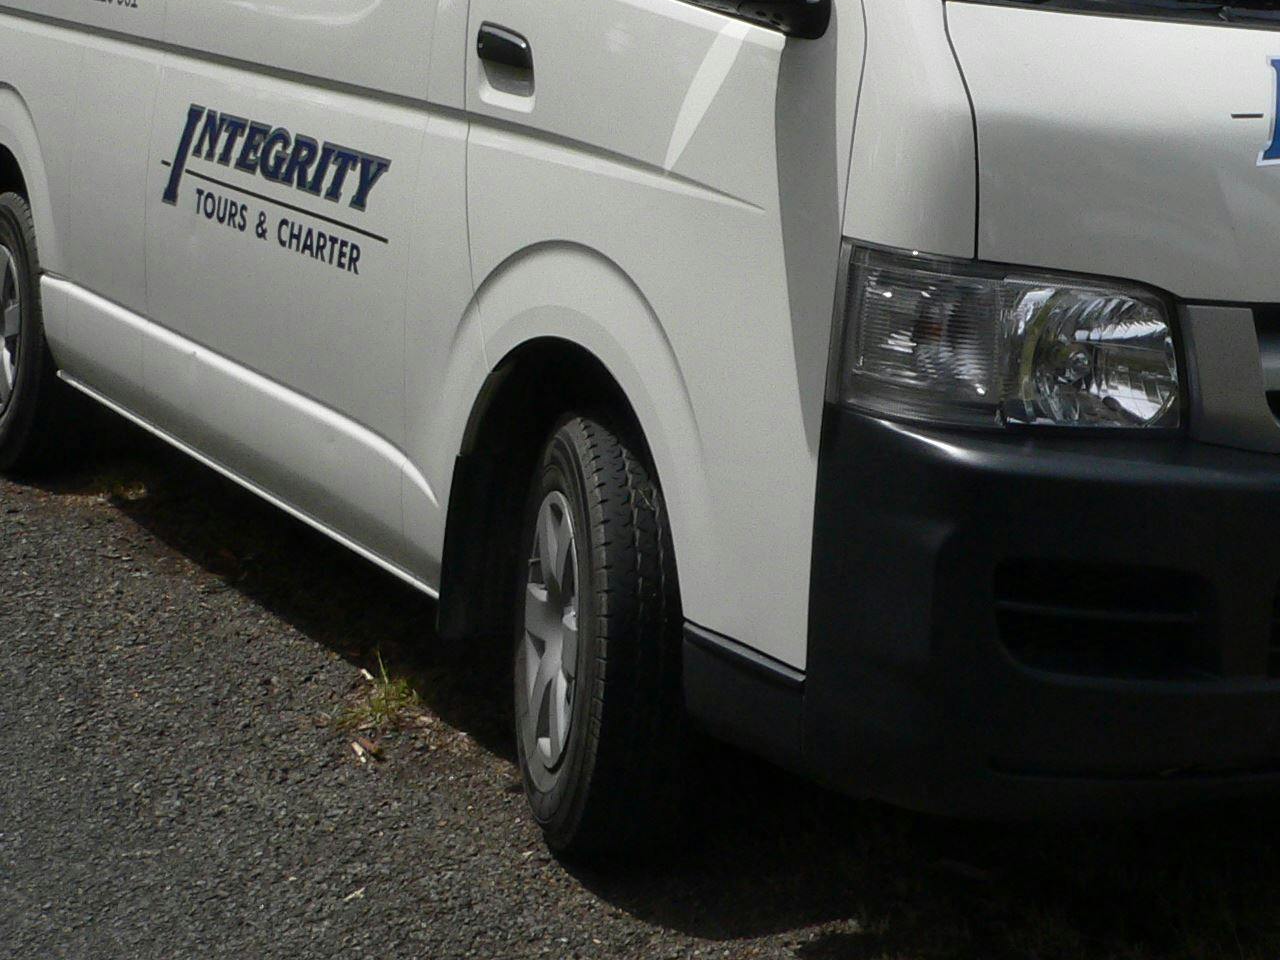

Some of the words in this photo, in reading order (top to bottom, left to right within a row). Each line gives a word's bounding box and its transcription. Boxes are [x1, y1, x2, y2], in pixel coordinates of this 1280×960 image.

[161, 103, 392, 212] INTEGRITY
[195, 188, 248, 232] TOURS
[255, 211, 268, 240] &
[277, 218, 361, 275] CHARTER
